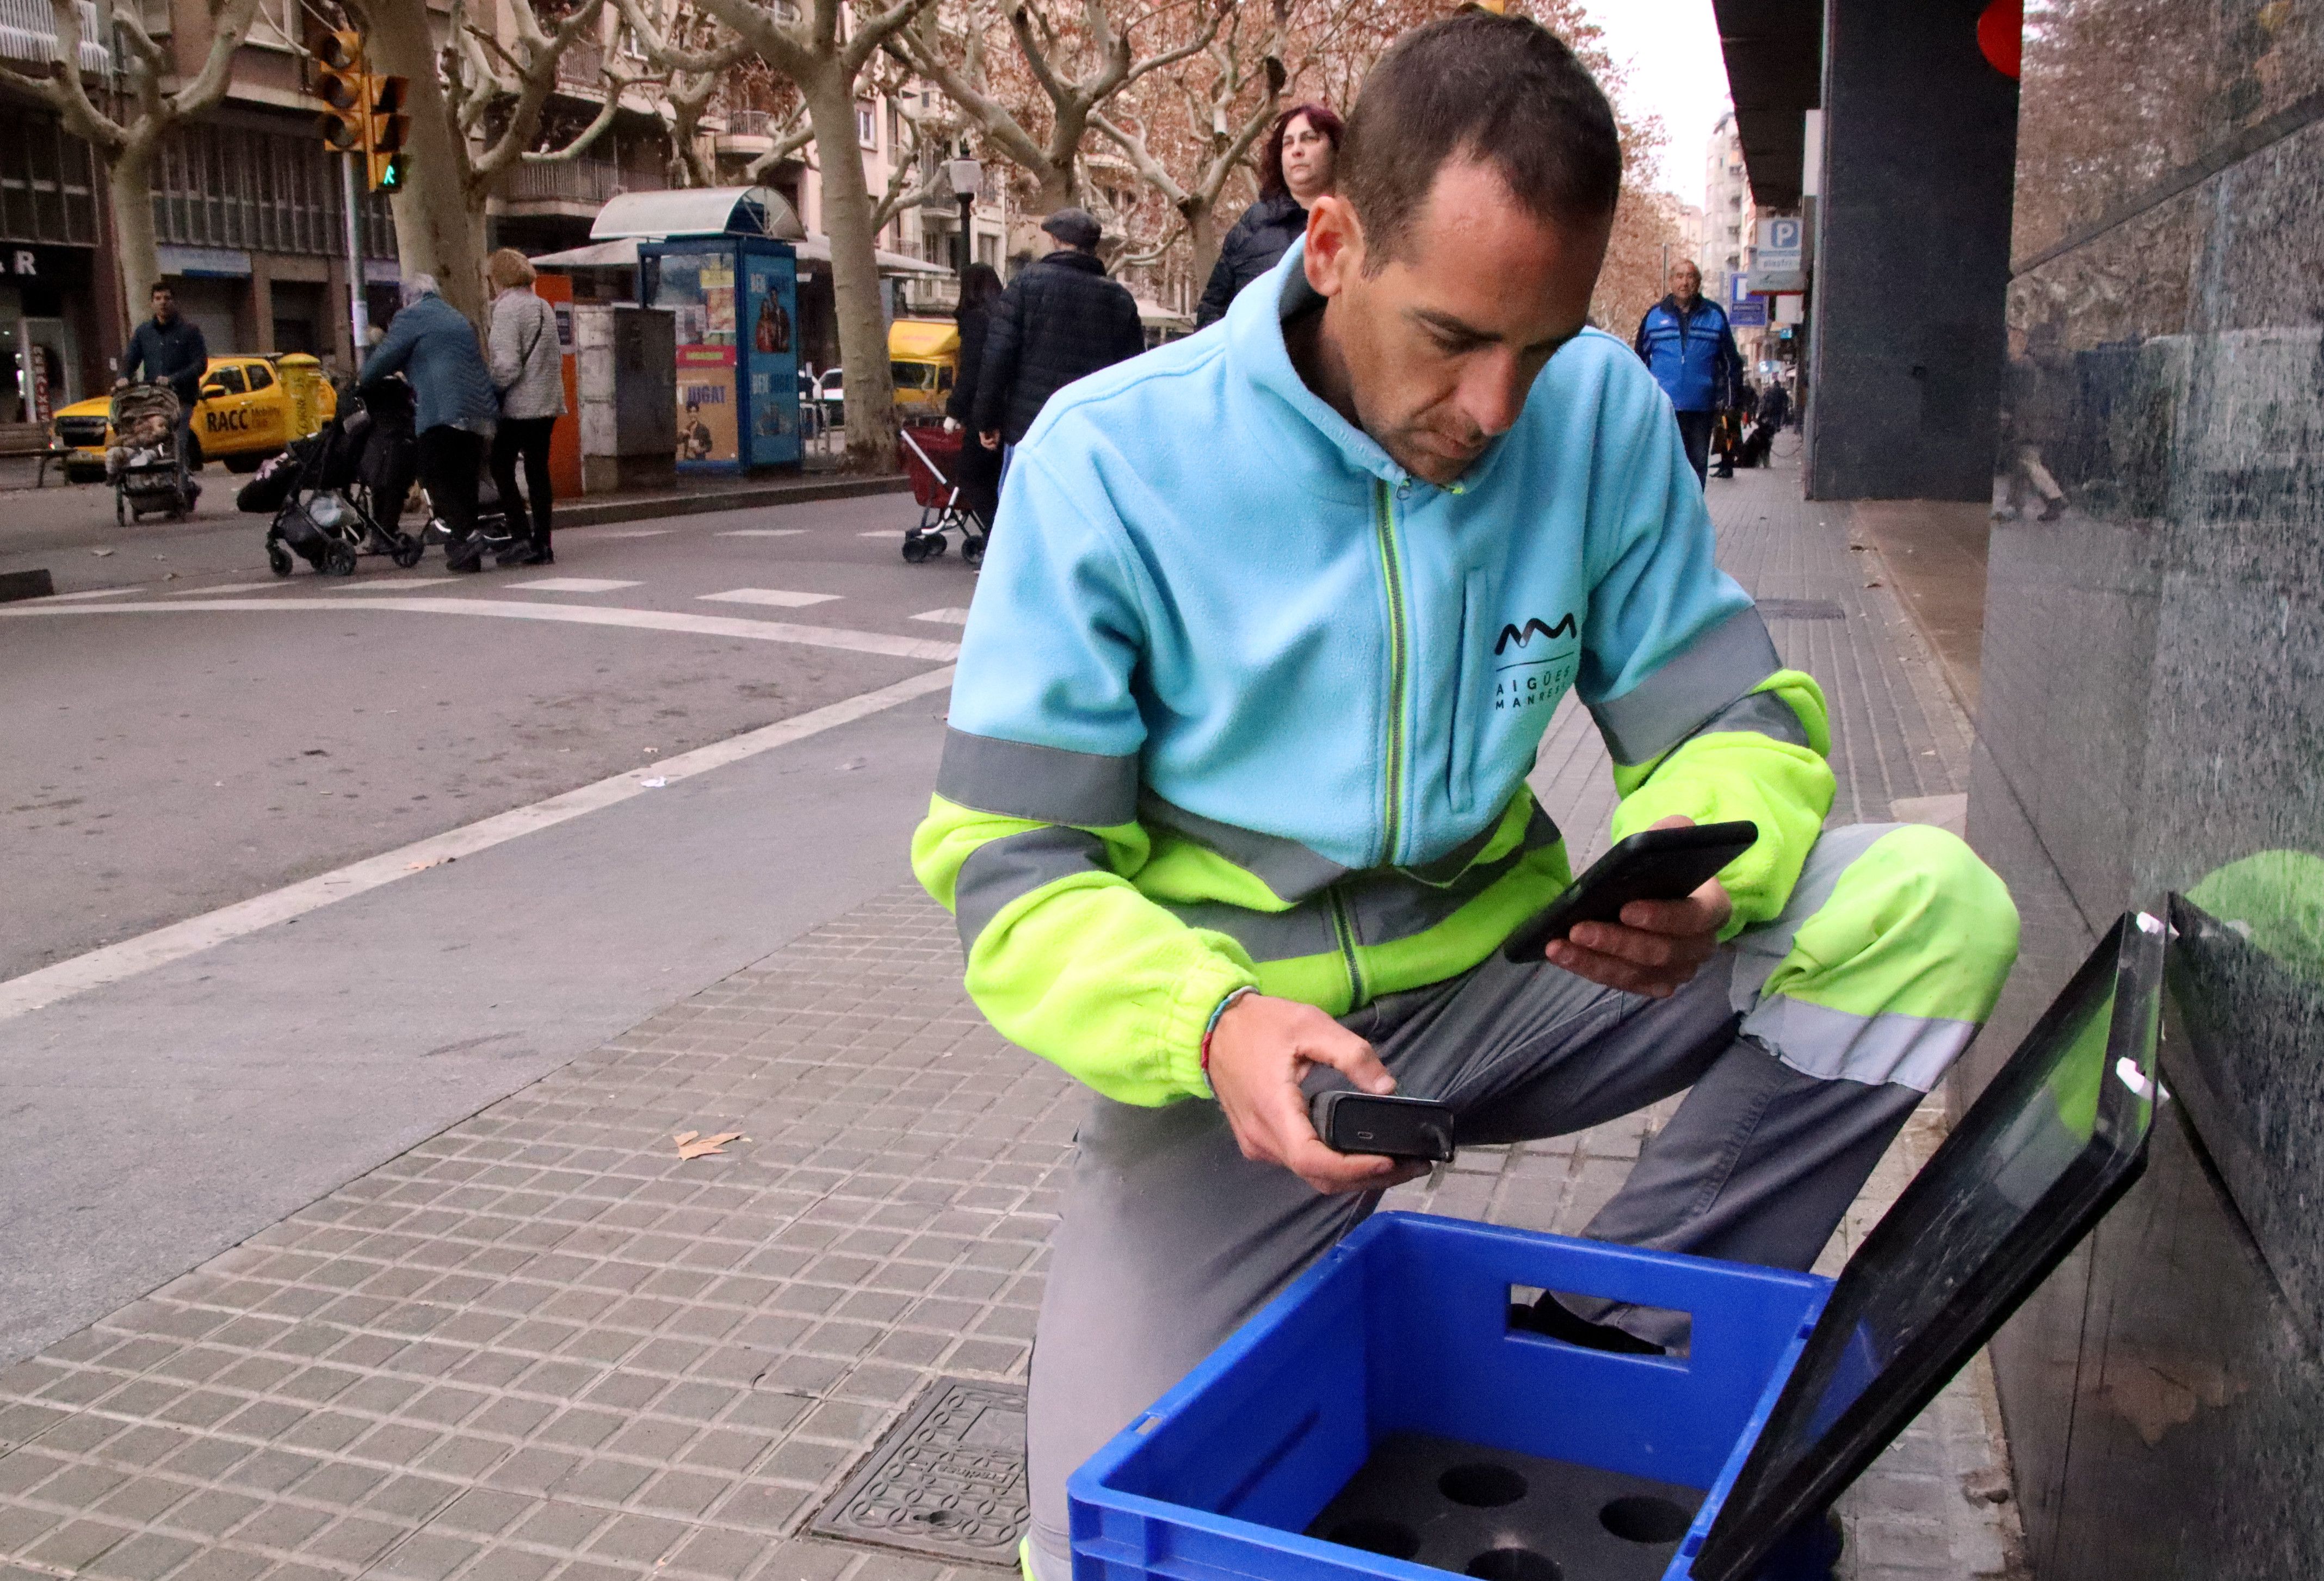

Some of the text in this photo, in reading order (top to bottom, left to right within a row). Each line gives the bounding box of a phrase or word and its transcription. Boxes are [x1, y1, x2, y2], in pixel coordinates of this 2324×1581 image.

[1776, 224, 1794, 246] P
[206, 409, 248, 432] RACC
[1496, 666, 1571, 697] AIGÜES
